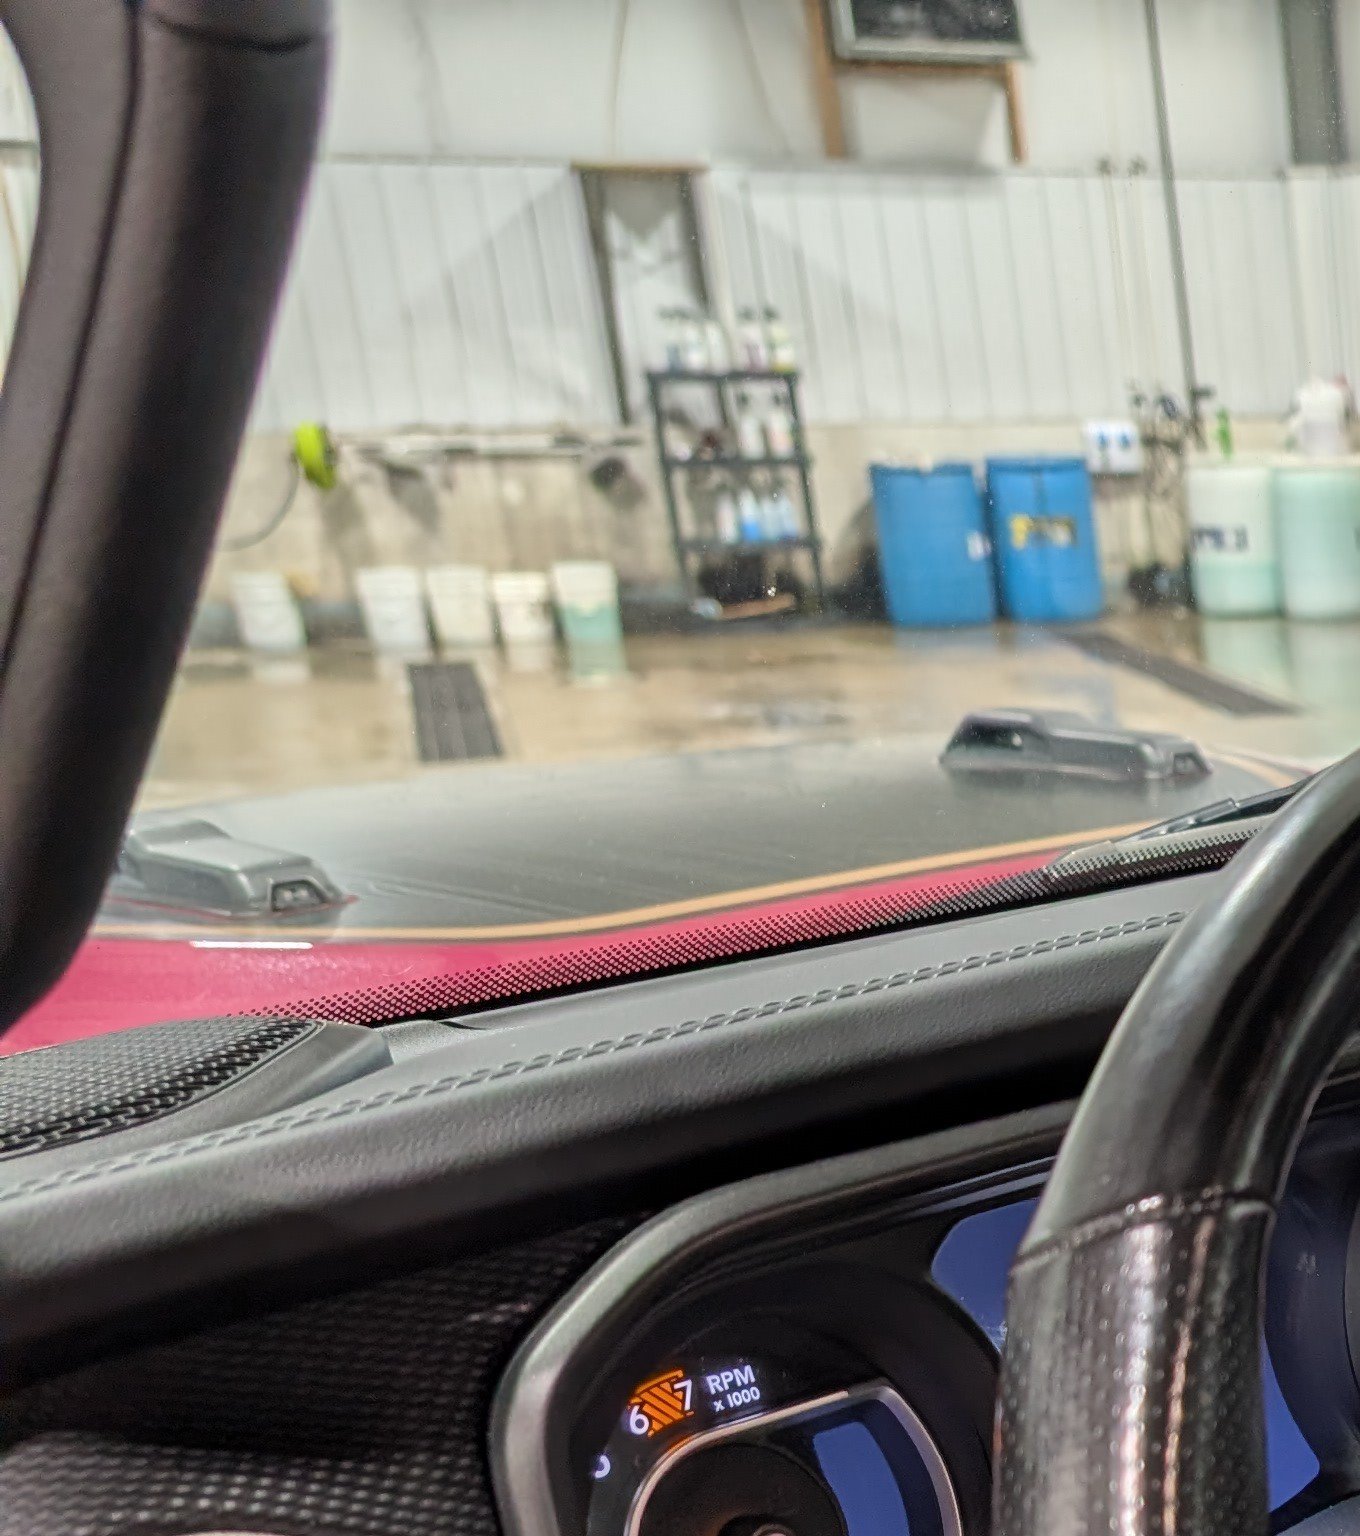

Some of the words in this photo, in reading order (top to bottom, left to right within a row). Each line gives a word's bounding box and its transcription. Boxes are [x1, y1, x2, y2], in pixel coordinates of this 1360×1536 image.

[673, 1379, 693, 1411] 7
[706, 1365, 756, 1395] RPM
[728, 1386, 761, 1408] 1000
[629, 1405, 650, 1435] 6
